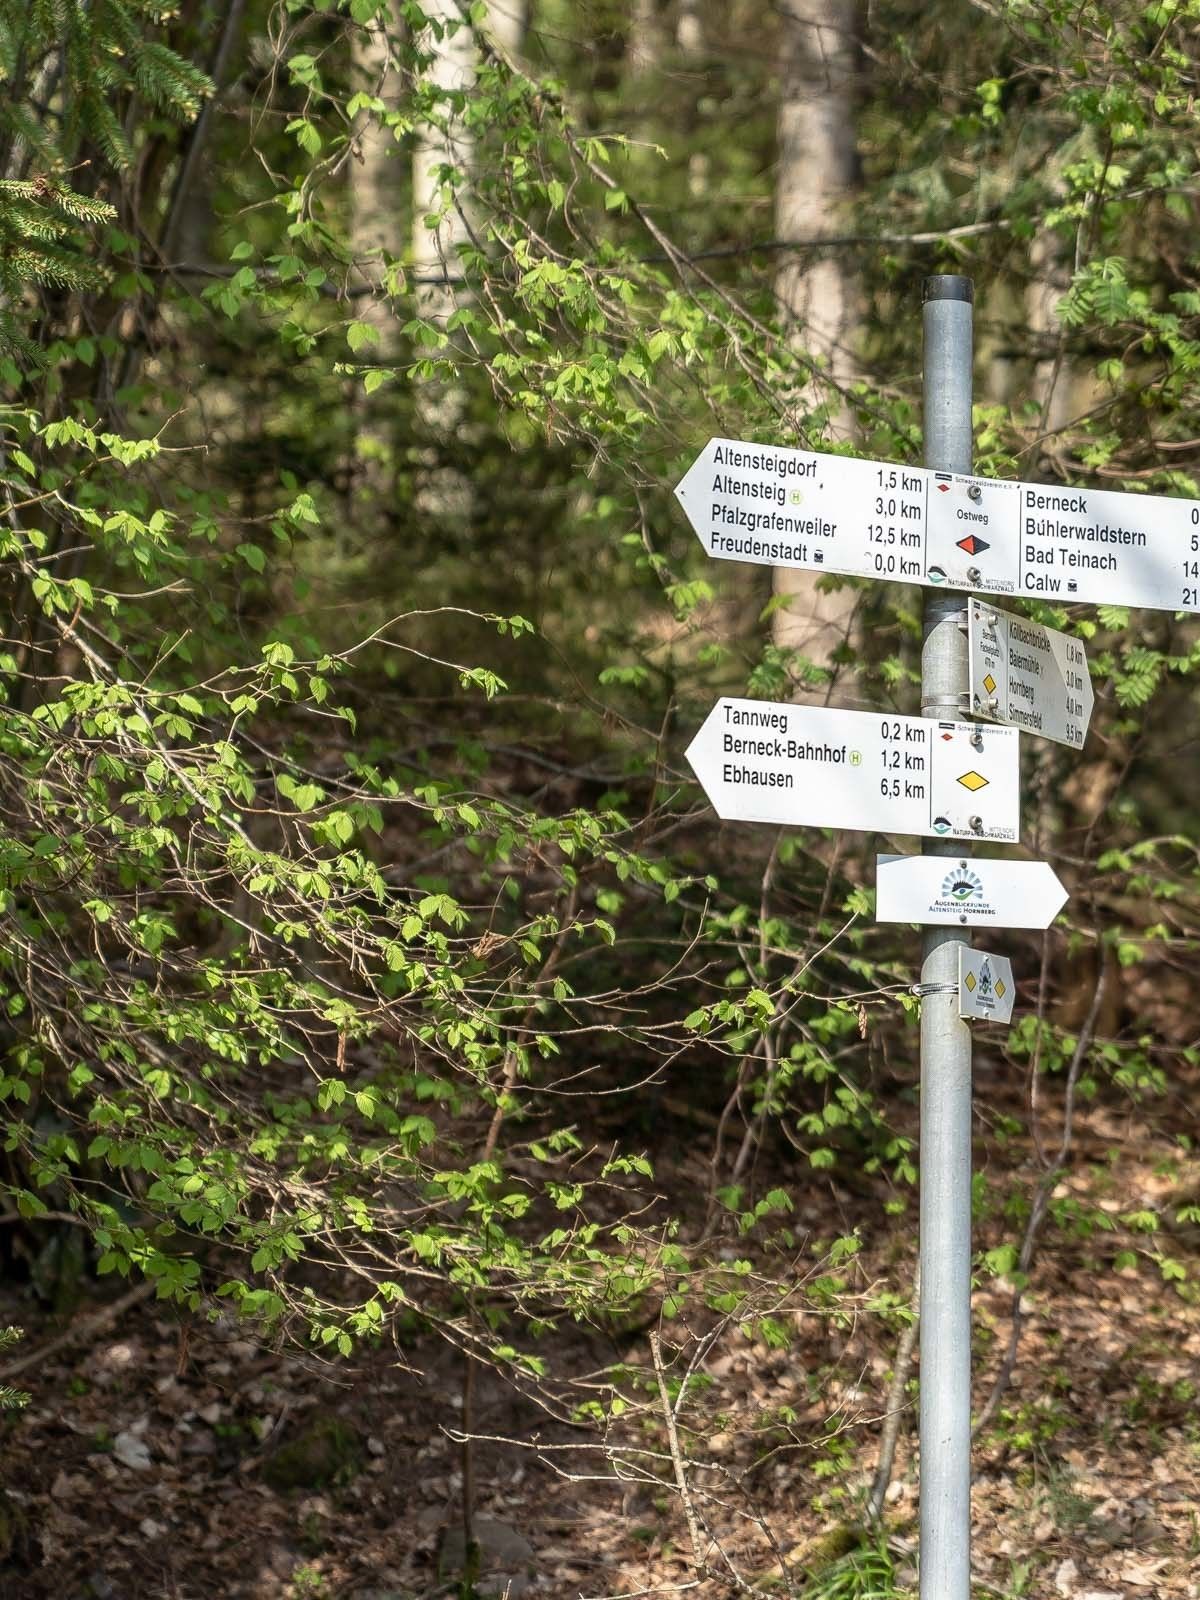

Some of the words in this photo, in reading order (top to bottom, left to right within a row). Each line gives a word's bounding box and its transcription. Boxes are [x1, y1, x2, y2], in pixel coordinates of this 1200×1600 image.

[713, 446, 817, 478] Altensteigdorf
[712, 474, 786, 506] Altensteig
[877, 469, 897, 490] 1,5
[902, 473, 922, 492] km
[876, 497, 896, 518] 3,0
[901, 500, 922, 520] km
[1026, 490, 1088, 514] Berneck
[712, 504, 837, 538] Pfalzgrafenweiler
[956, 508, 989, 526] Ostweg
[710, 532, 808, 562] Freudenstadt
[868, 524, 896, 546] 12,5
[900, 528, 921, 548] km
[864, 552, 895, 575] 0,0
[900, 556, 920, 576] km
[1025, 546, 1054, 564] Bad
[1058, 548, 1117, 571] Teinach
[1025, 572, 1061, 592] Calw
[1009, 620, 1050, 653] Köllbachbrücke
[1009, 648, 1040, 675] Baiermühle
[1074, 646, 1082, 665] km
[1009, 676, 1034, 705] Hornberg
[1074, 672, 1082, 692] km
[724, 705, 788, 734] Tannweg
[1008, 702, 1042, 730] Simmersfeld
[1074, 698, 1082, 718] km
[881, 721, 901, 742] 0,2
[906, 724, 926, 743] km
[1074, 725, 1082, 744] km
[724, 734, 846, 764] Berneck-Bahnhof
[881, 750, 900, 771] 1,2
[905, 752, 925, 771] km
[723, 764, 794, 788] Ebhausen
[880, 778, 900, 799] 6,5
[905, 780, 925, 799] km
